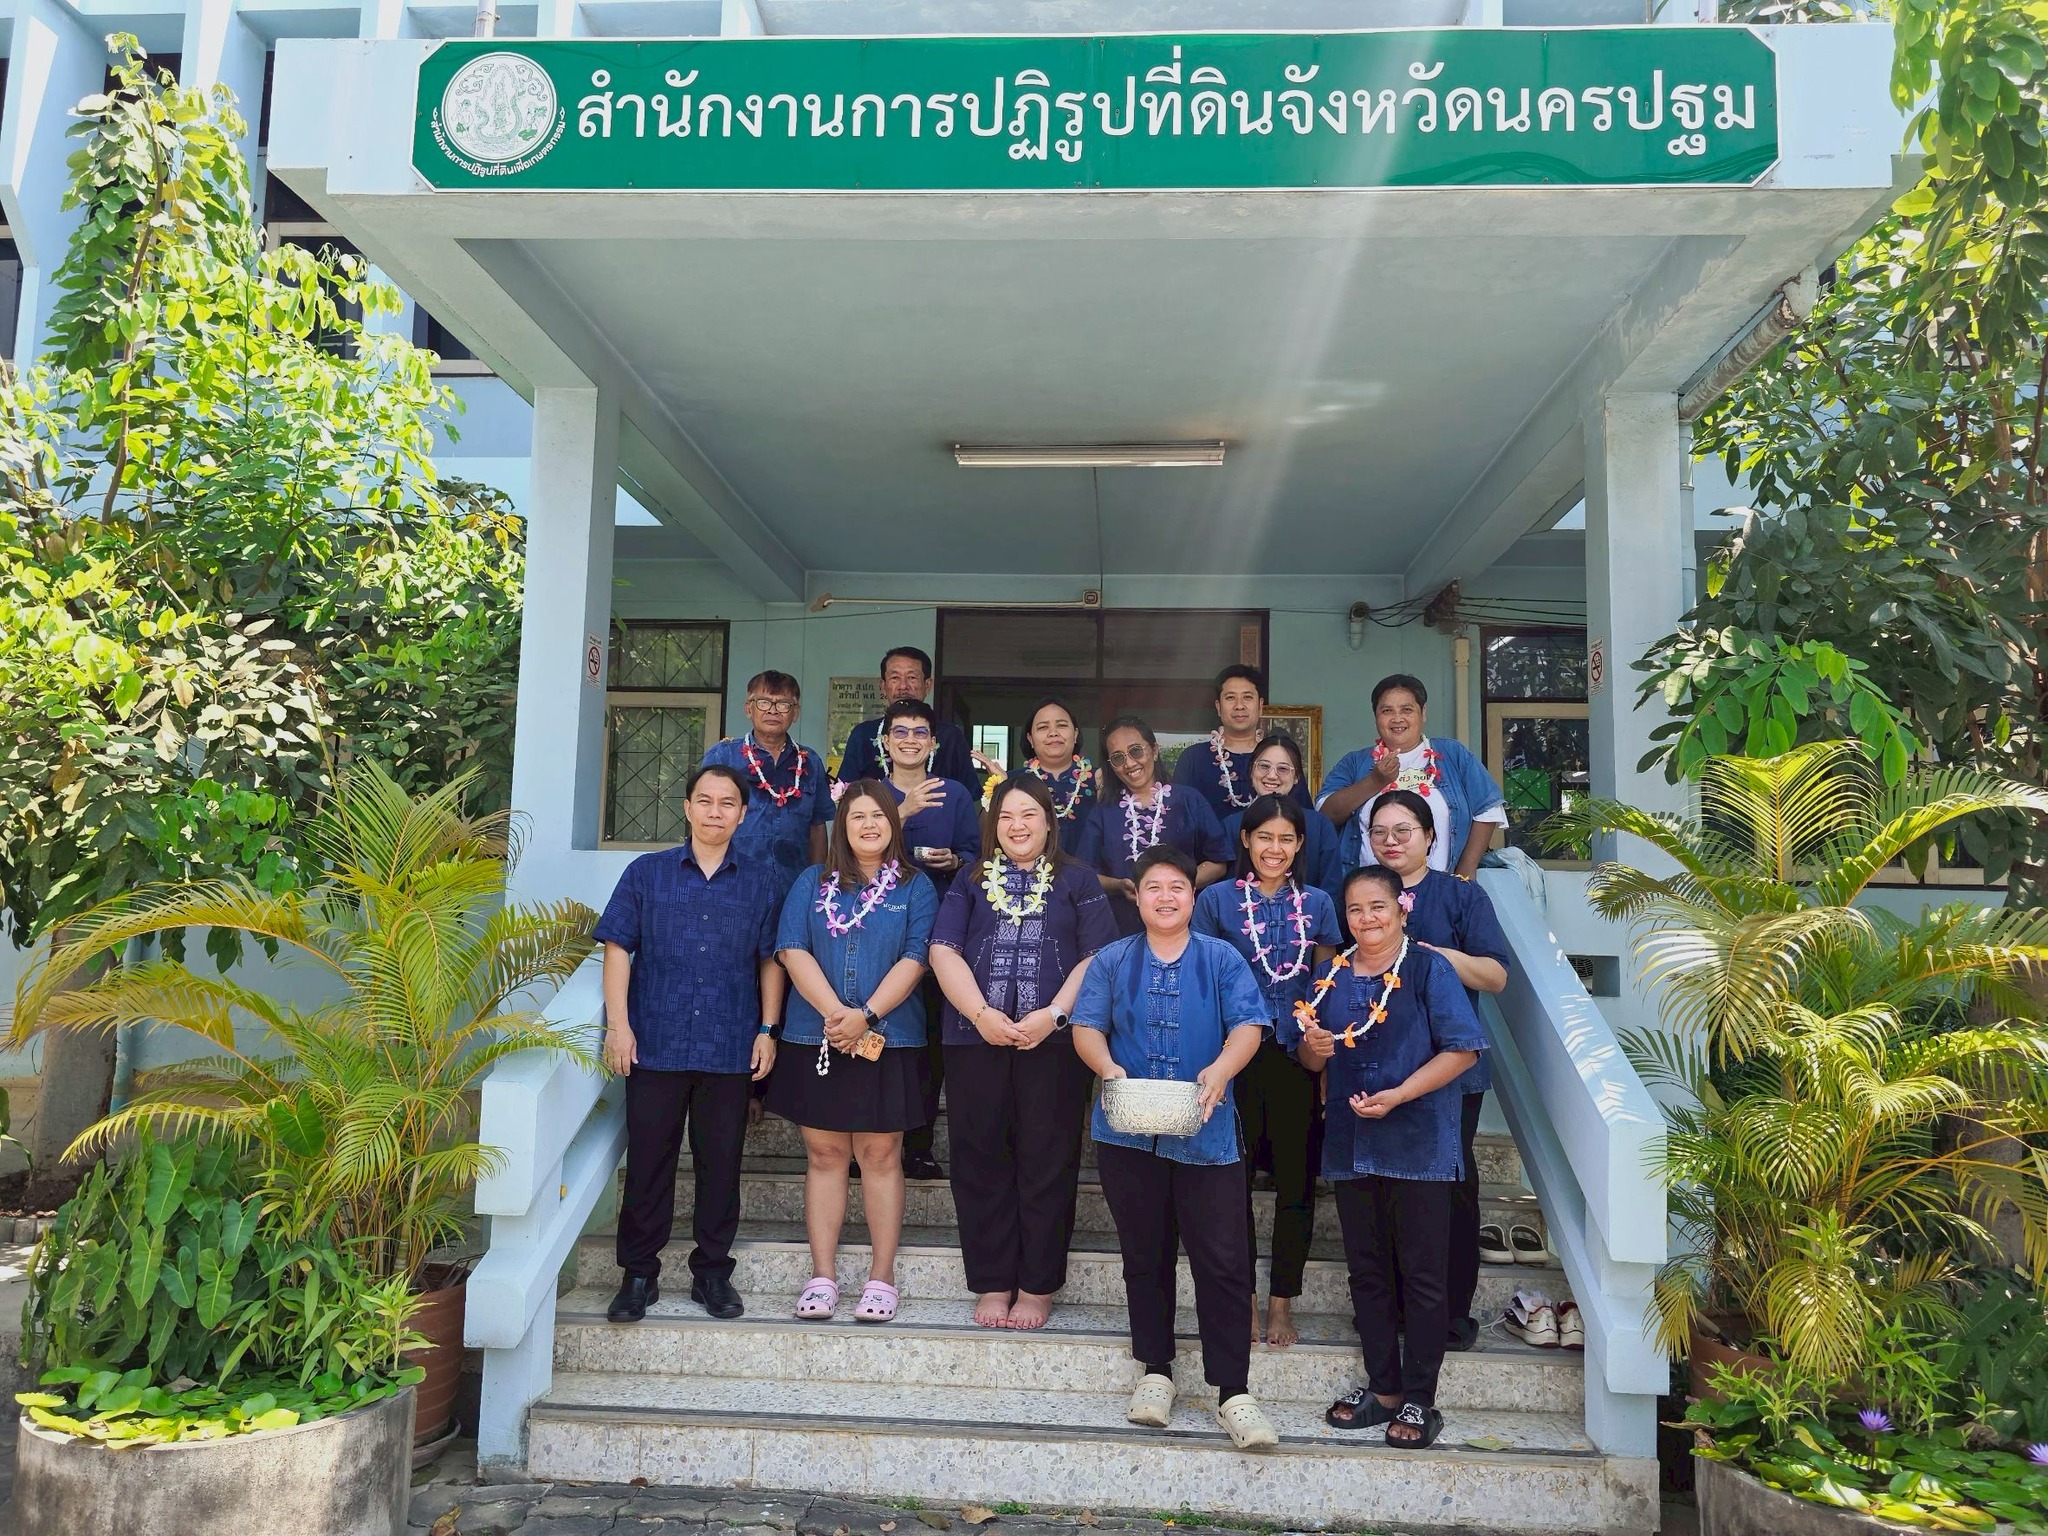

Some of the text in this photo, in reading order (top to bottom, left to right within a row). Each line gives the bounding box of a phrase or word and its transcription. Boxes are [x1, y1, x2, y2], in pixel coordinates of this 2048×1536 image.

[577, 46, 1756, 162] สำนักงานการปฏิรูปที่ดินจังหวัดนครปฐม
[430, 120, 567, 177] สำนักงานการปฏิรูปที่ดินเพื่อเกษตรกรรม
